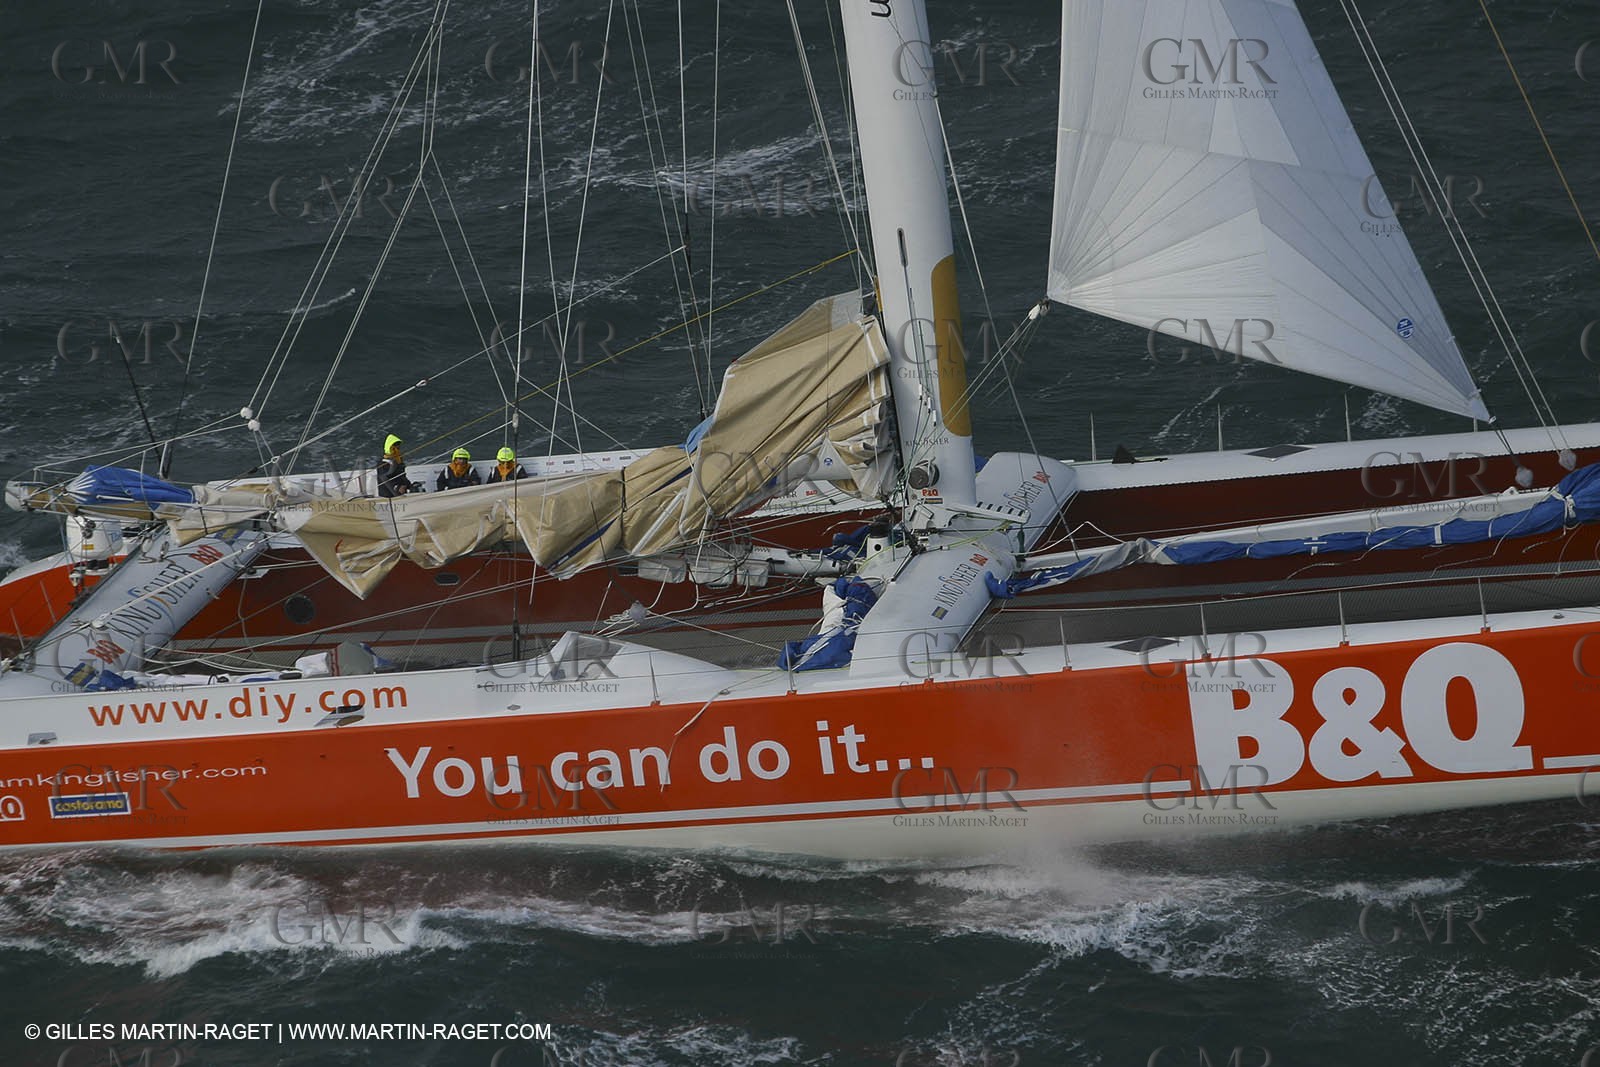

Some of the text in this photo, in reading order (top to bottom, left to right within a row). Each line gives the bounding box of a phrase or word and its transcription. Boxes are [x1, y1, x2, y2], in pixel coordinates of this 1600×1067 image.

[88, 685, 408, 727] www.diy.com
[1185, 642, 1533, 791] B&Q
[384, 720, 934, 798] You can do it...
[54, 799, 124, 813] castorama
